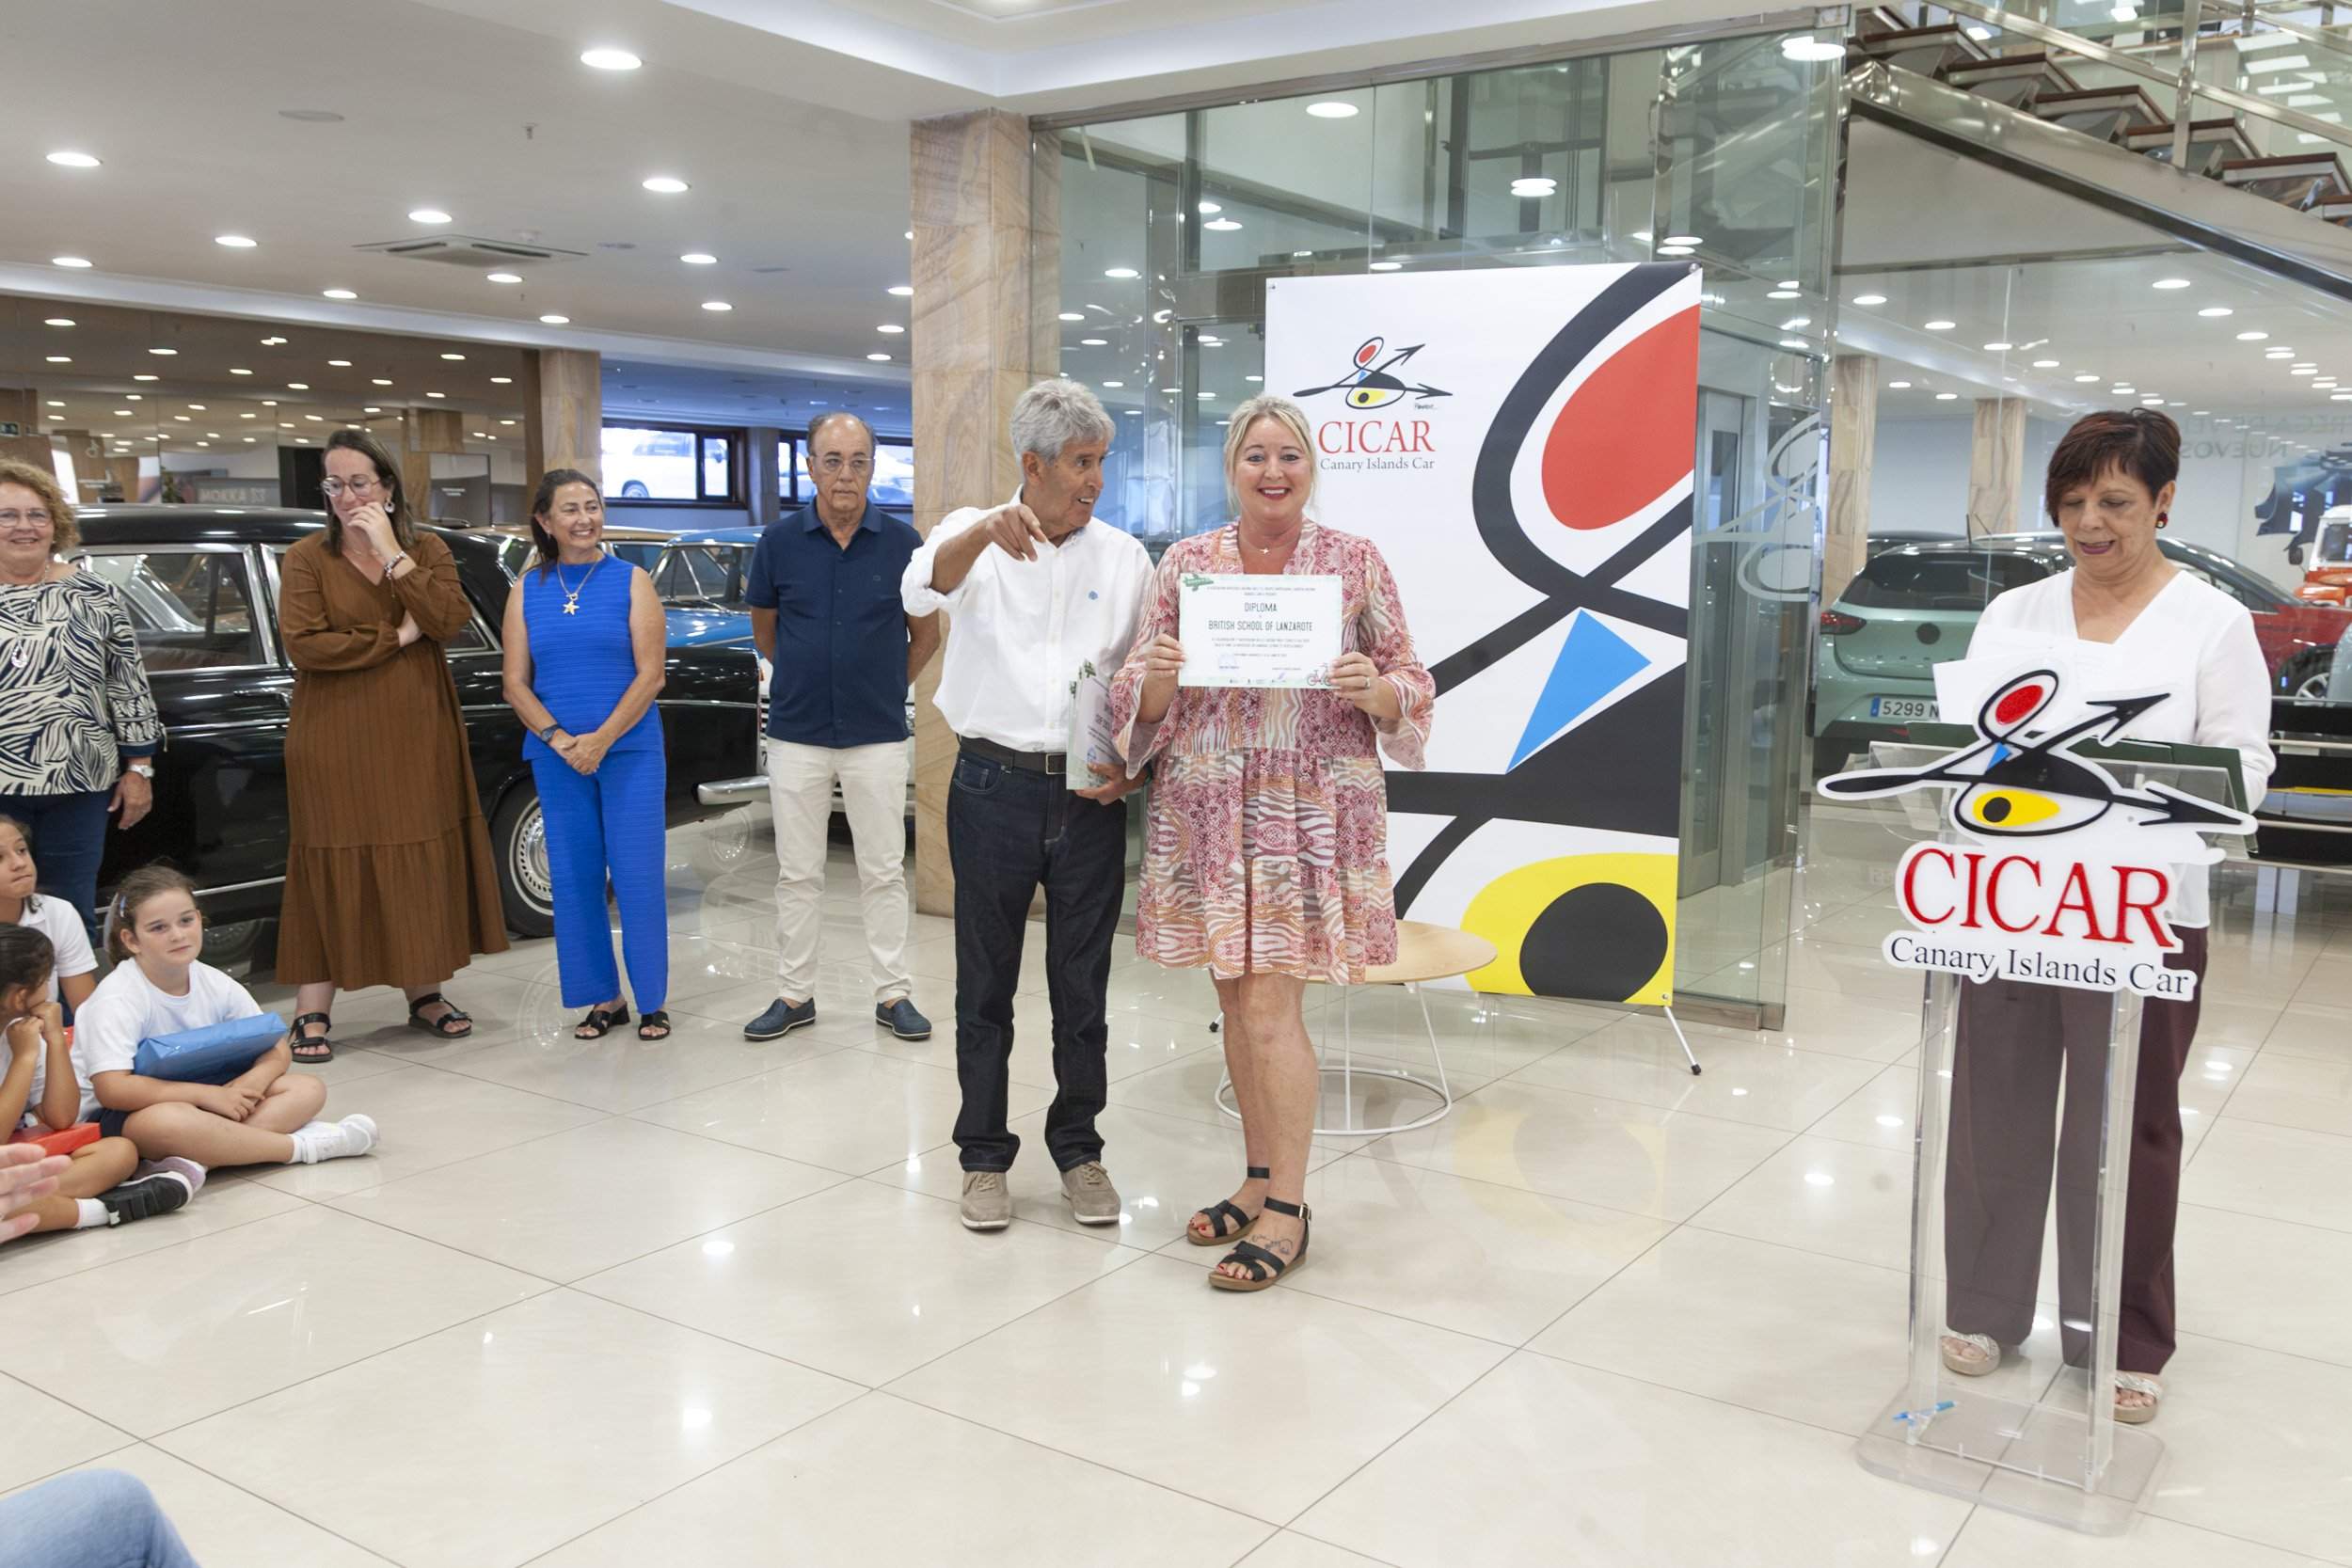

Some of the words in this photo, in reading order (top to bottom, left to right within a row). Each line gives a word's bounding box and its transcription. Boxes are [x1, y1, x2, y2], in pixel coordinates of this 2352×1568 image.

[1318, 420, 1436, 454] CICAR
[1320, 458, 1364, 472] Canary
[1367, 457, 1409, 470] Islands
[1412, 457, 1435, 469] Car
[1245, 602, 1278, 612] DIPLOMA
[1208, 620, 1235, 630] BRITISH
[1237, 620, 1263, 630] SCHOOL
[1265, 621, 1273, 631] OF
[1276, 621, 1313, 631] LANZAROTE
[1883, 701, 1925, 717] 5299
[1903, 847, 2174, 948] CICAR
[1891, 937, 1994, 977] Canary
[2009, 948, 2116, 987] Islands
[2129, 963, 2190, 994] Car
